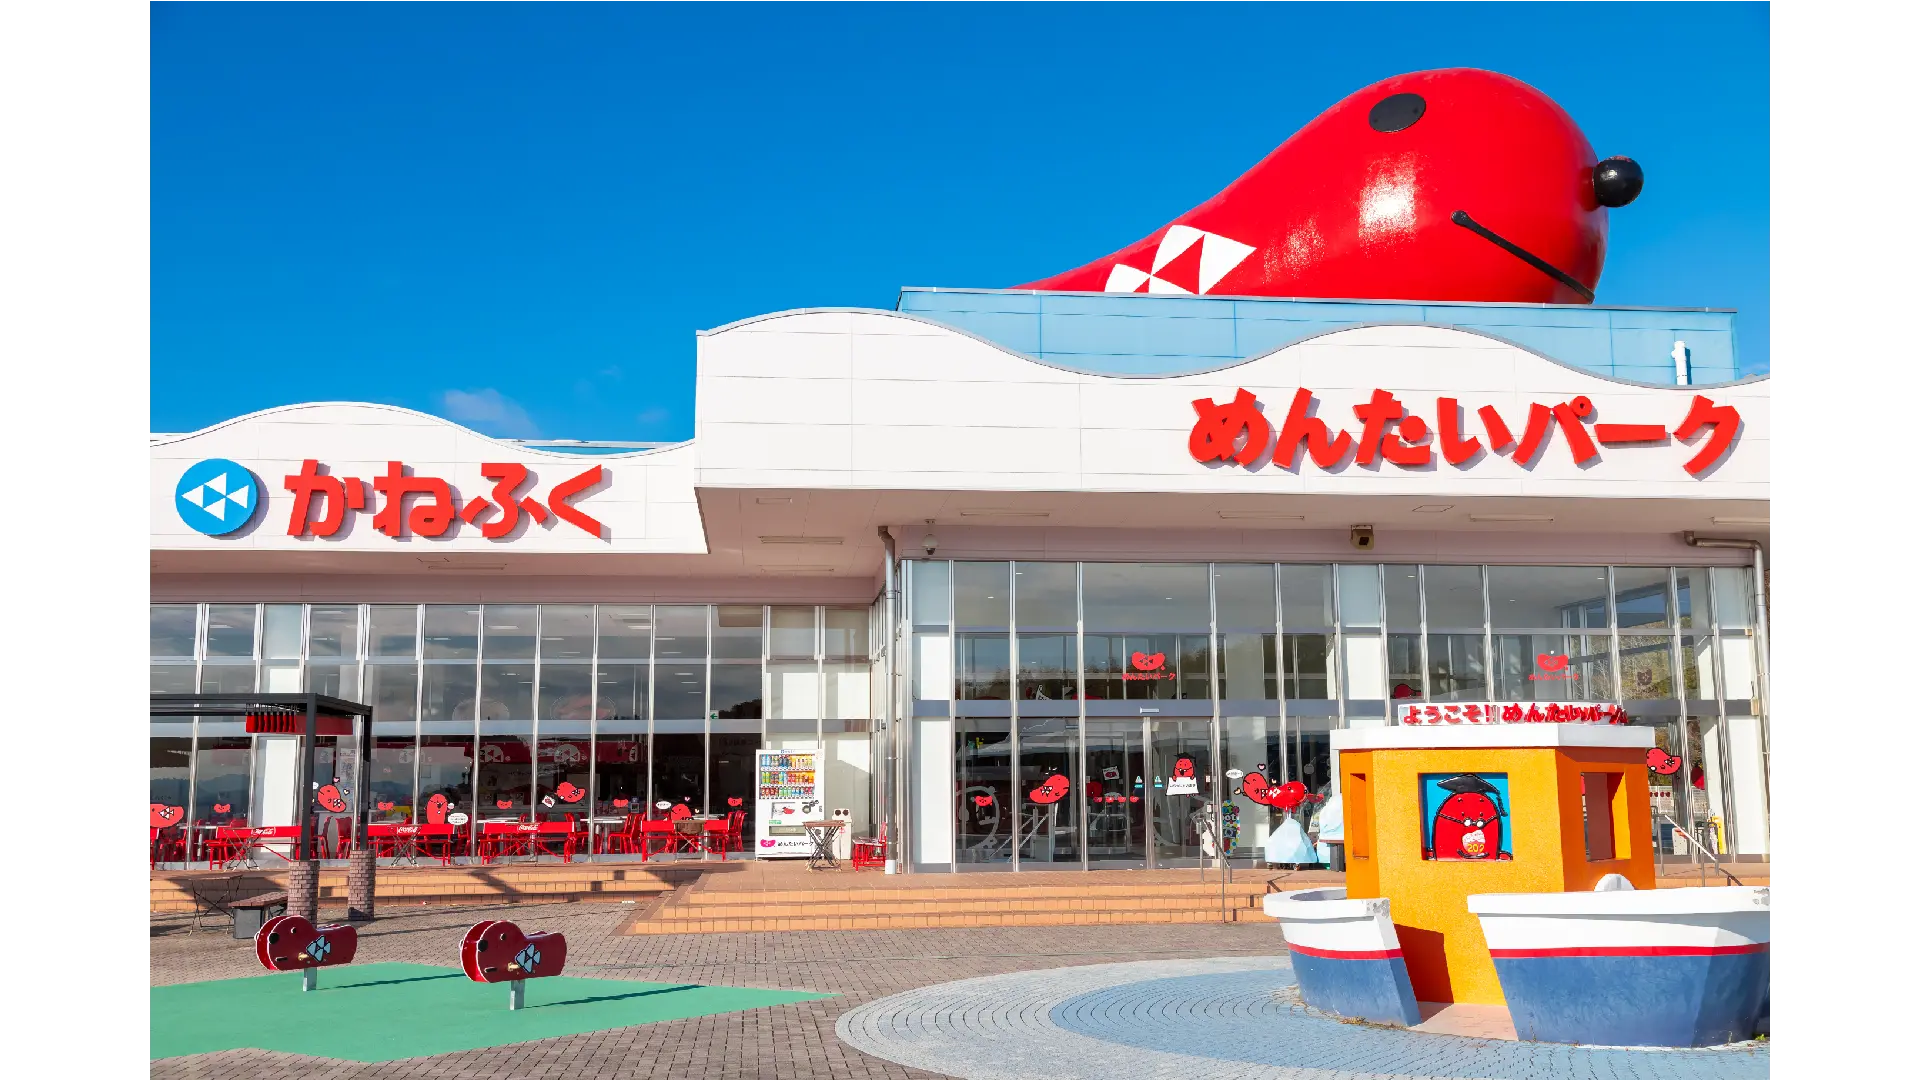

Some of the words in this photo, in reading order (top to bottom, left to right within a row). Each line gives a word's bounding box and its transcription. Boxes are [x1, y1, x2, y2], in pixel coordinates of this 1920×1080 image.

[1188, 387, 1741, 477] めんたいパーク
[284, 458, 602, 539] かねふく
[1121, 672, 1176, 681] めんたいパーク
